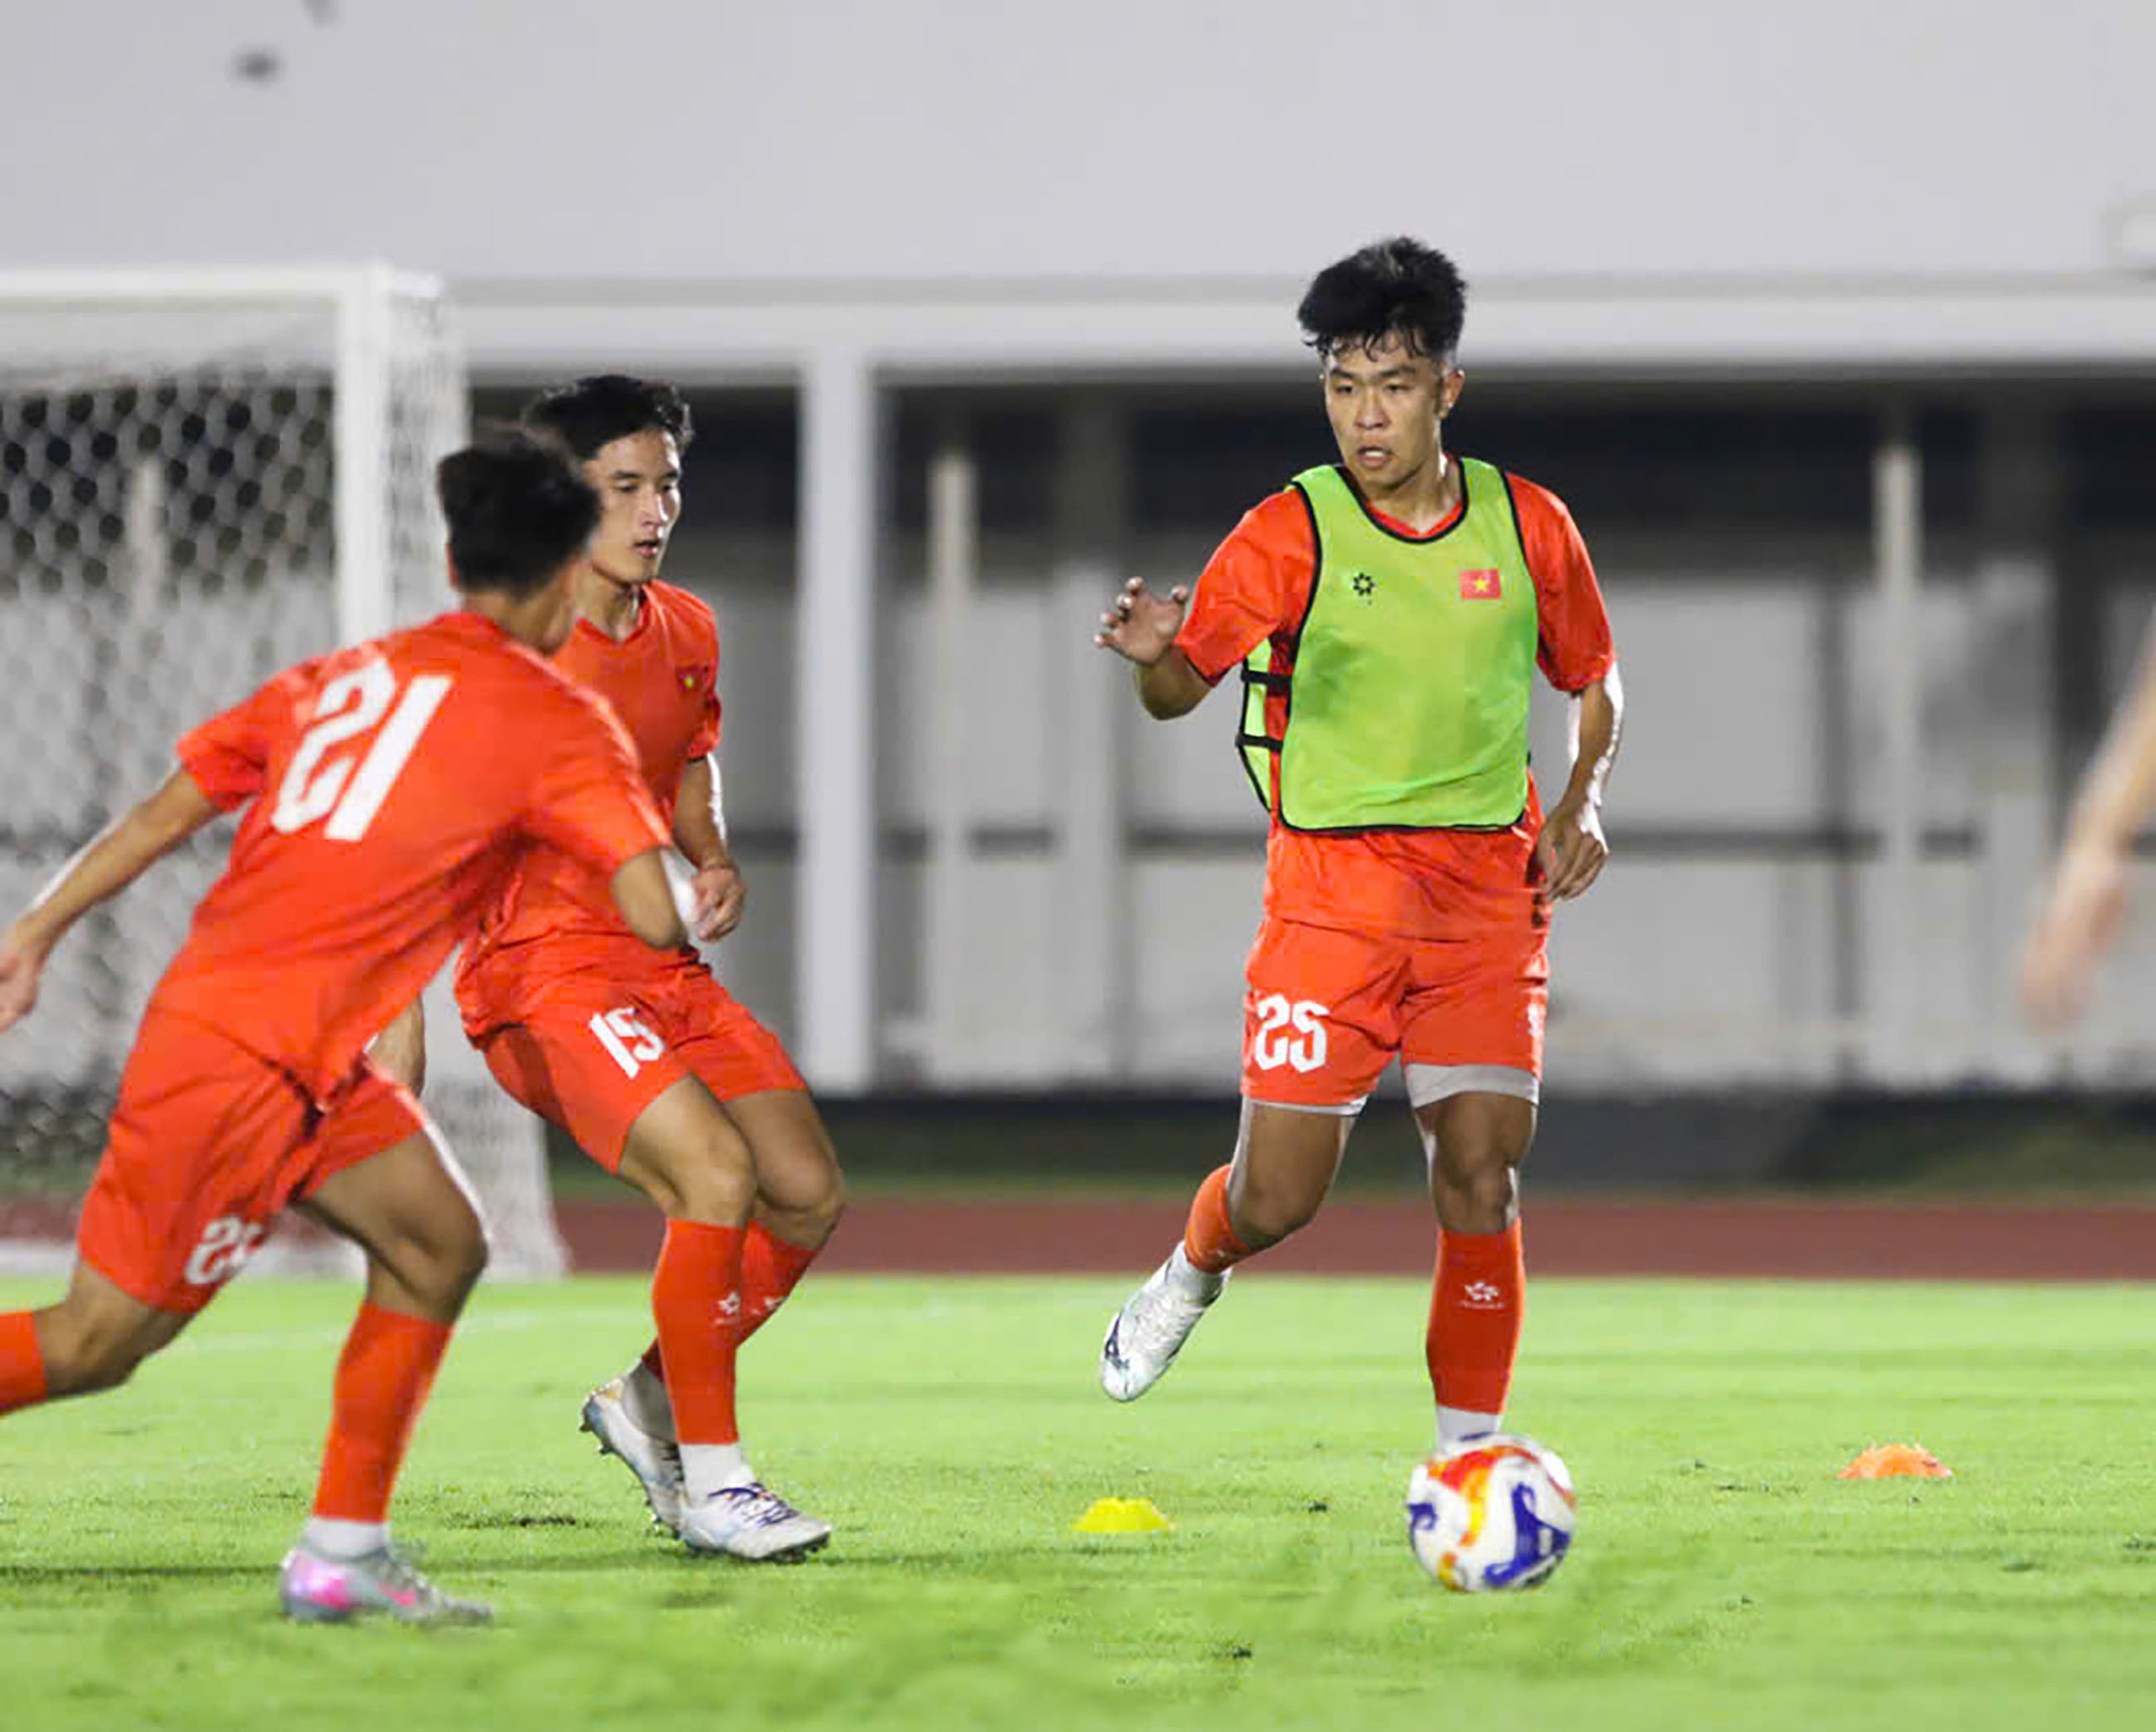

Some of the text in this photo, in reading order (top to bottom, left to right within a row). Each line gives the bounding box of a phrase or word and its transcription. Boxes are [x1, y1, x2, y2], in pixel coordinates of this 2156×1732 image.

[271, 656, 452, 841] 21
[590, 1007, 664, 1079] 15
[1255, 993, 1330, 1073] 25
